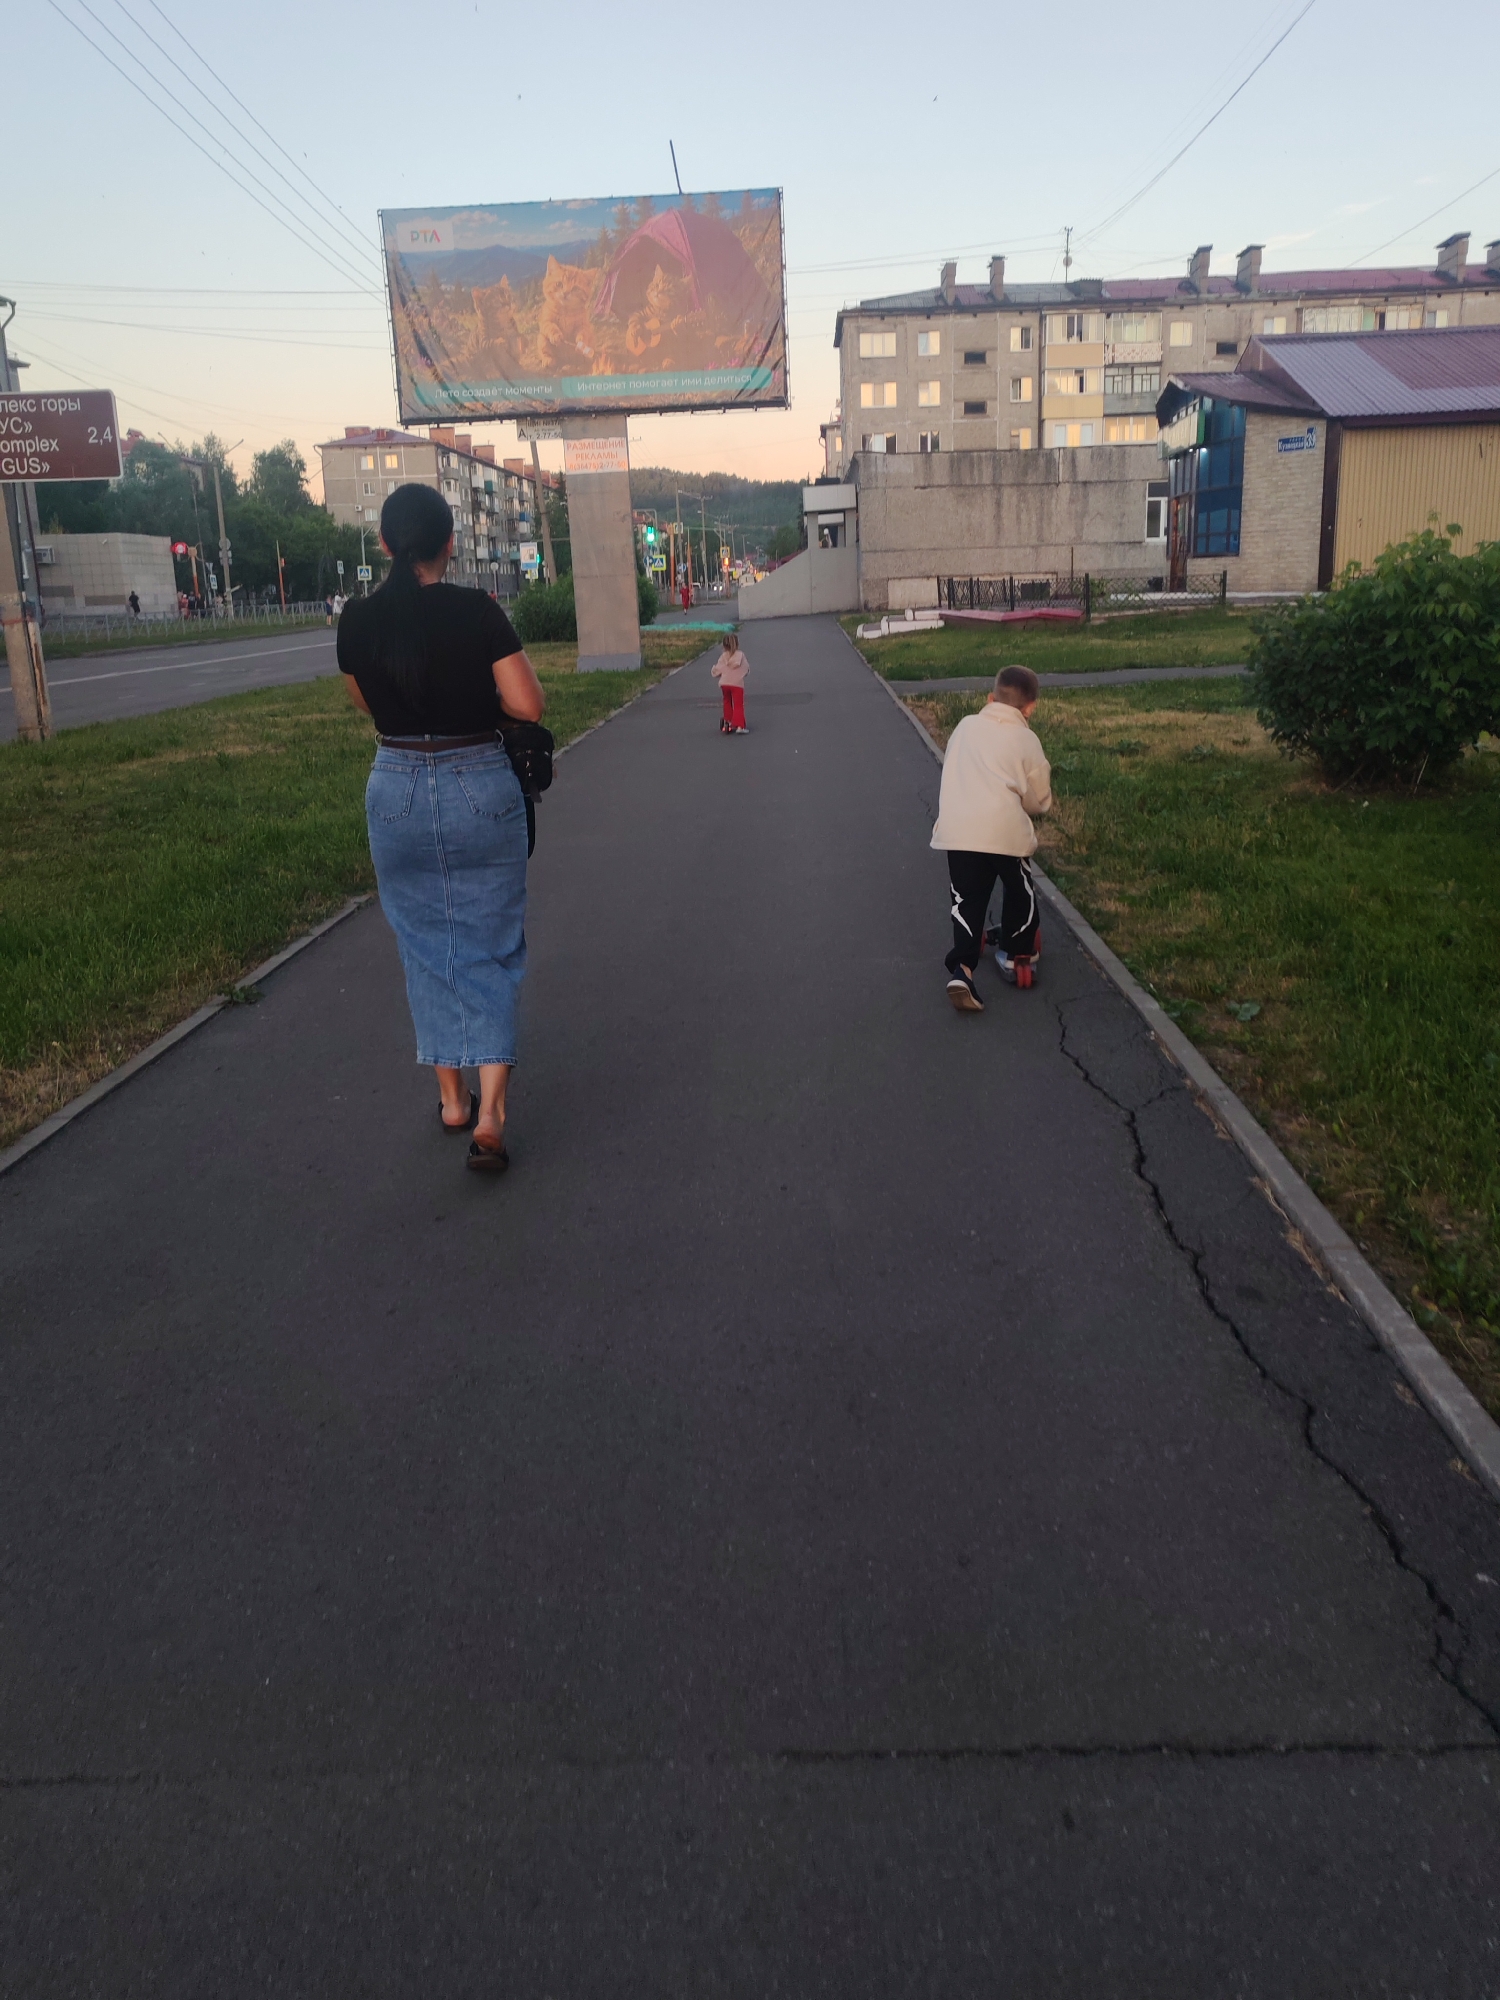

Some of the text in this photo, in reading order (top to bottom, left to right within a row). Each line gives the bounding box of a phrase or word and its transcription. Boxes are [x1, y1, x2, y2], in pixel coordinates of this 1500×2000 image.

[577, 374, 752, 391] Интернет помогает ими делиться
[435, 385, 552, 399] Лето создаёт моменты
[42, 398, 80, 415] горы
[88, 427, 112, 445] 2,4
[567, 440, 625, 450] РАЗМЕЩЕНИЕ
[576, 451, 617, 460] РЕКЛАМЫ
